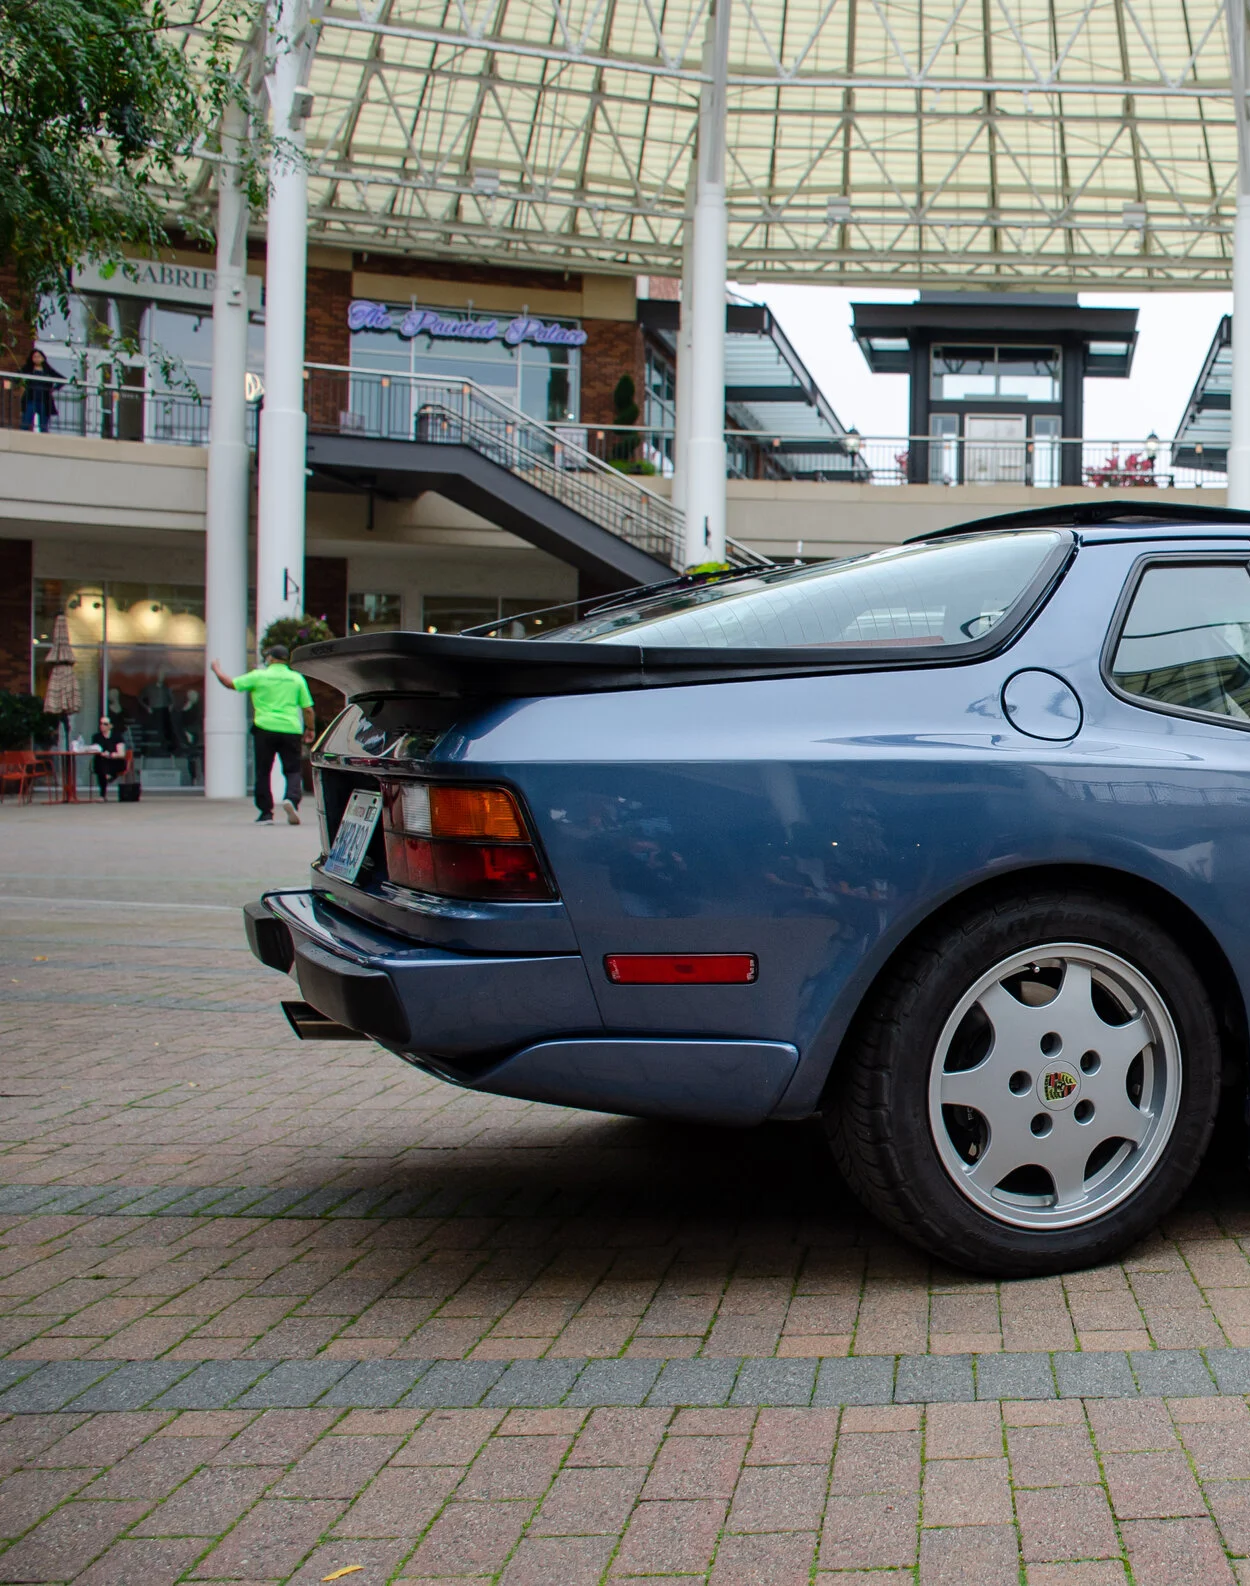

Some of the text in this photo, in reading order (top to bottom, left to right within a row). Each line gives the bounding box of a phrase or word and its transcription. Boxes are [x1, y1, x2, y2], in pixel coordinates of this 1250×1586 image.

[122, 262, 217, 291] GABRIE
[348, 301, 588, 345] The Painted Palace
